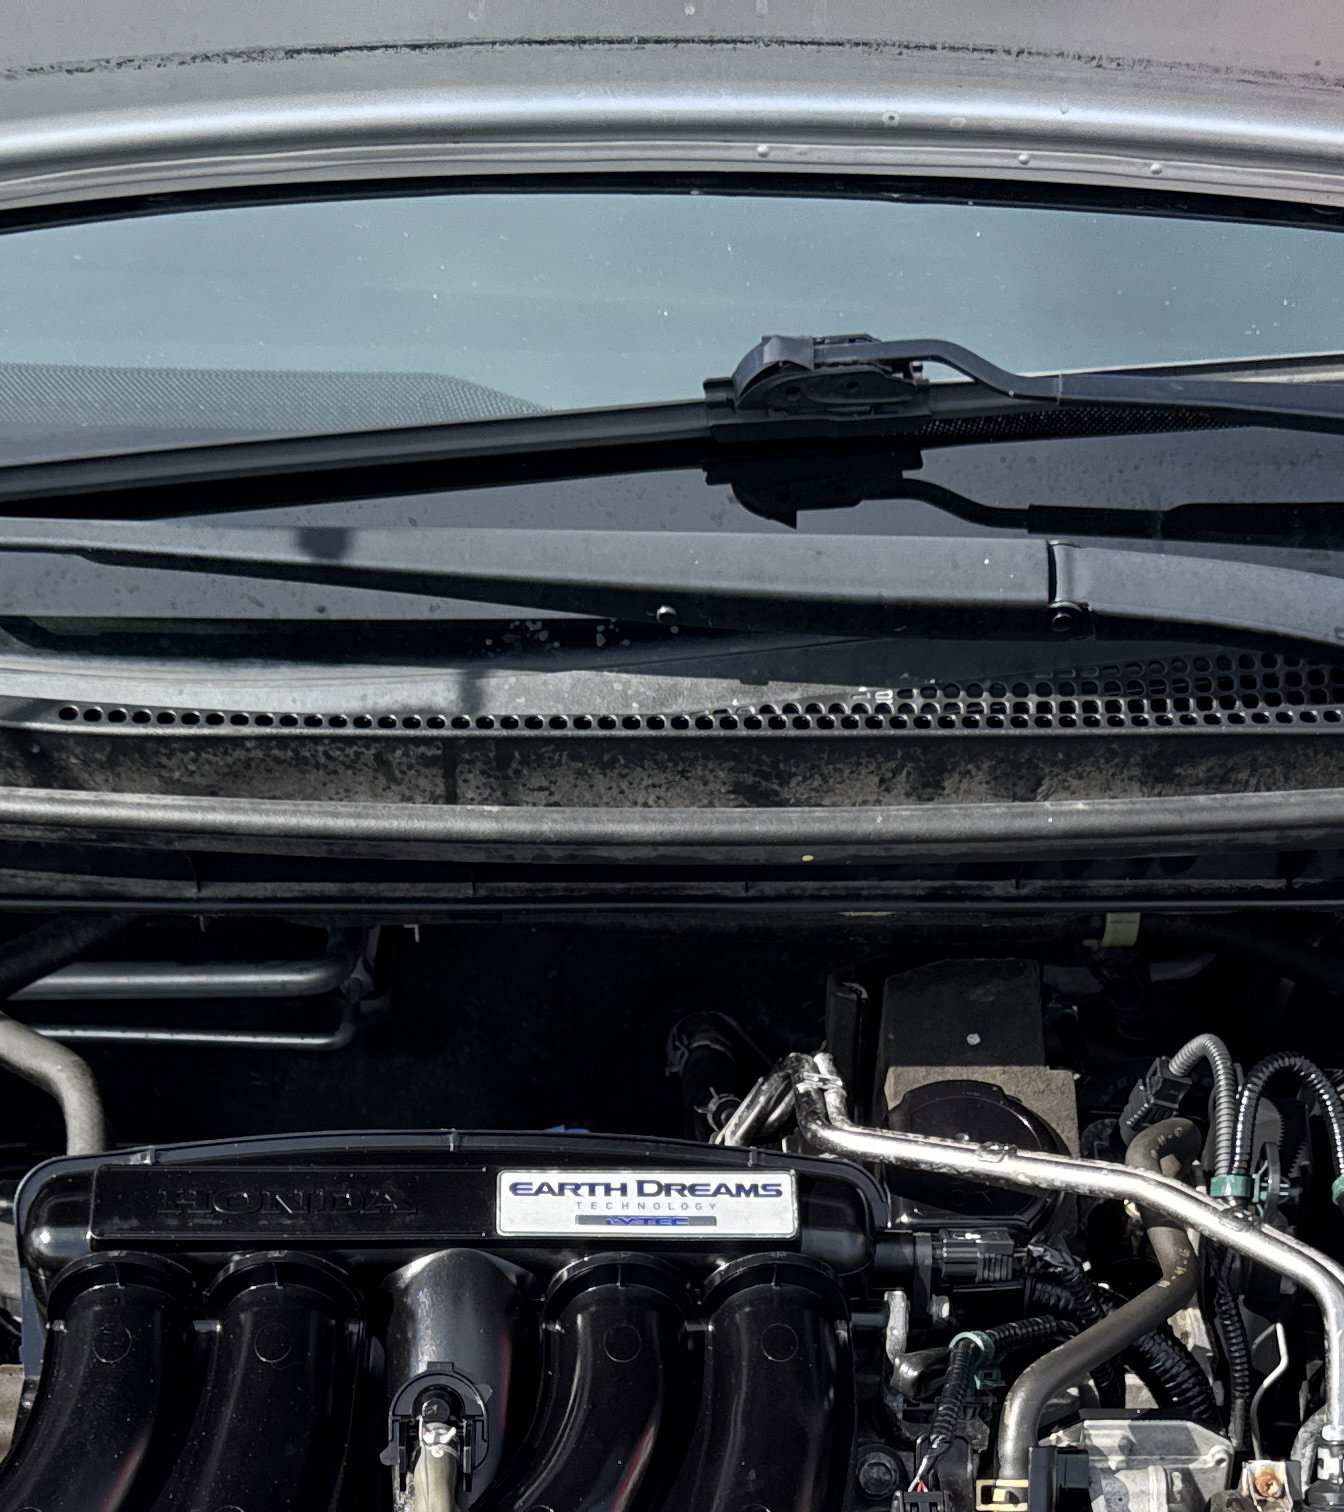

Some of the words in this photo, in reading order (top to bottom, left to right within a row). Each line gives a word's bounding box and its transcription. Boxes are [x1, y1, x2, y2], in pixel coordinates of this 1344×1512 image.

[509, 1181, 629, 1198] EARTH
[636, 1179, 784, 1198] DREAMS
[157, 1188, 418, 1214] HONDA
[576, 1201, 718, 1211] TECHNOLOGY
